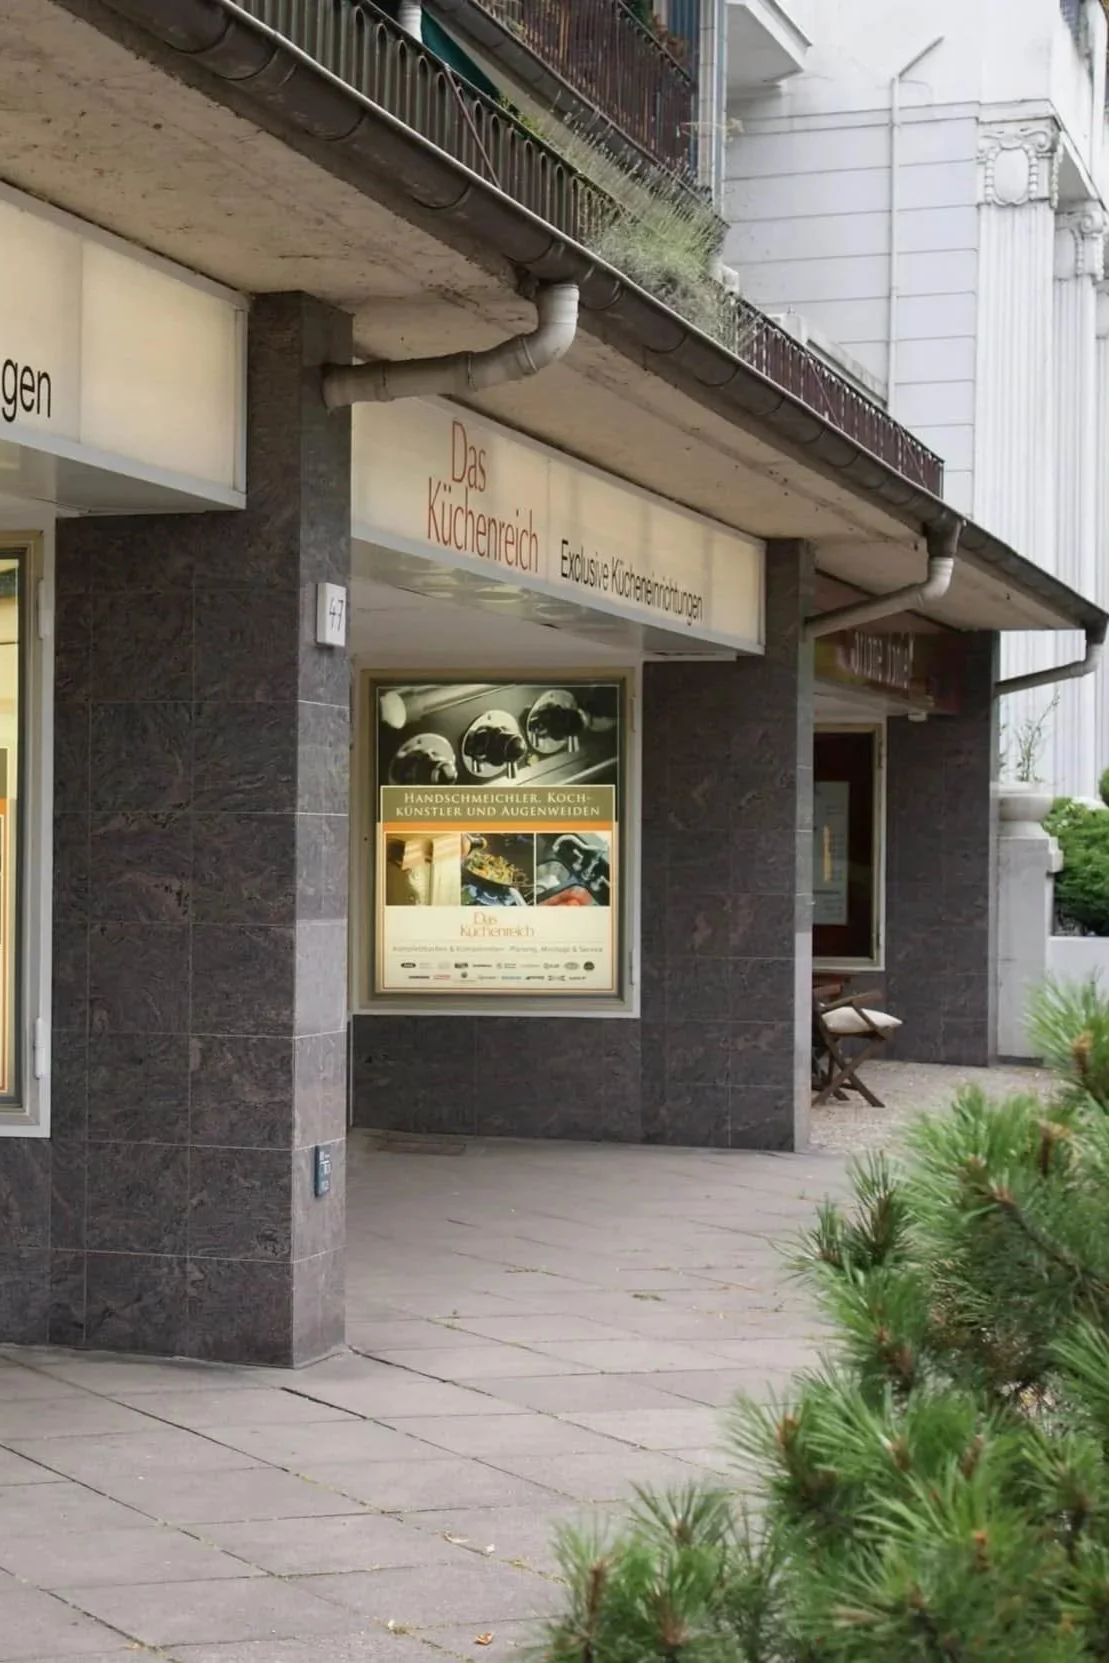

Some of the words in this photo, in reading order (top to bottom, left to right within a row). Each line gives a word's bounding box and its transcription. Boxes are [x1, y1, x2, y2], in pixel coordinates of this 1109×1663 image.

[452, 419, 486, 493] Das
[427, 476, 539, 574] Küchenreich
[561, 538, 609, 591] Exclusive
[612, 556, 703, 627] Kücheneinrichtungen
[468, 806, 497, 817] UND
[501, 805, 600, 818] AUGENWEIDEN
[474, 910, 497, 925] Das
